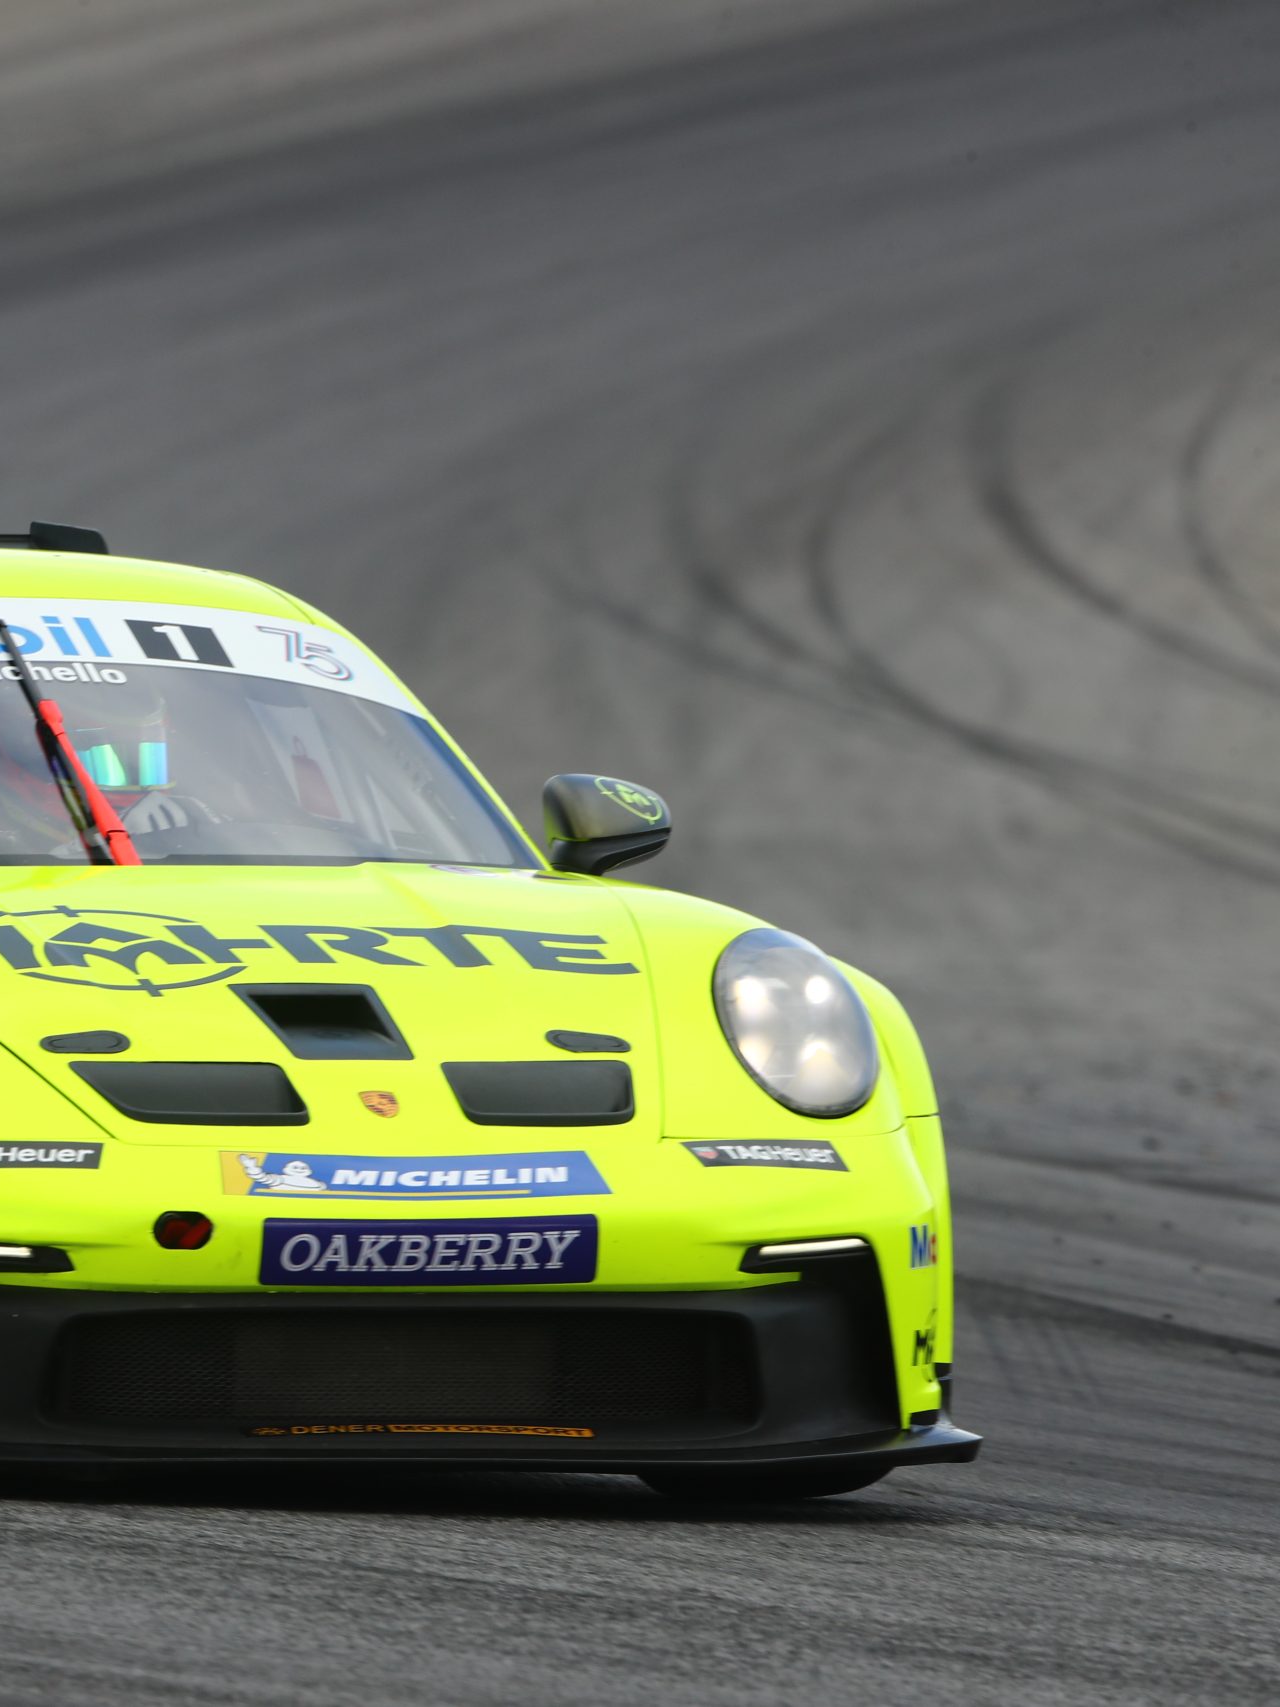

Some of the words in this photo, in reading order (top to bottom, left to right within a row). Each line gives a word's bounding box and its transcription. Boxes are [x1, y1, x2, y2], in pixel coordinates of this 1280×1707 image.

[152, 625, 200, 662] 1
[256, 624, 356, 681] 75
[331, 1166, 570, 1187] MICHELIN
[280, 1230, 582, 1272] OAKBERRY
[290, 1424, 385, 1434] DENER
[391, 1425, 589, 1437] MOTORSPORT
